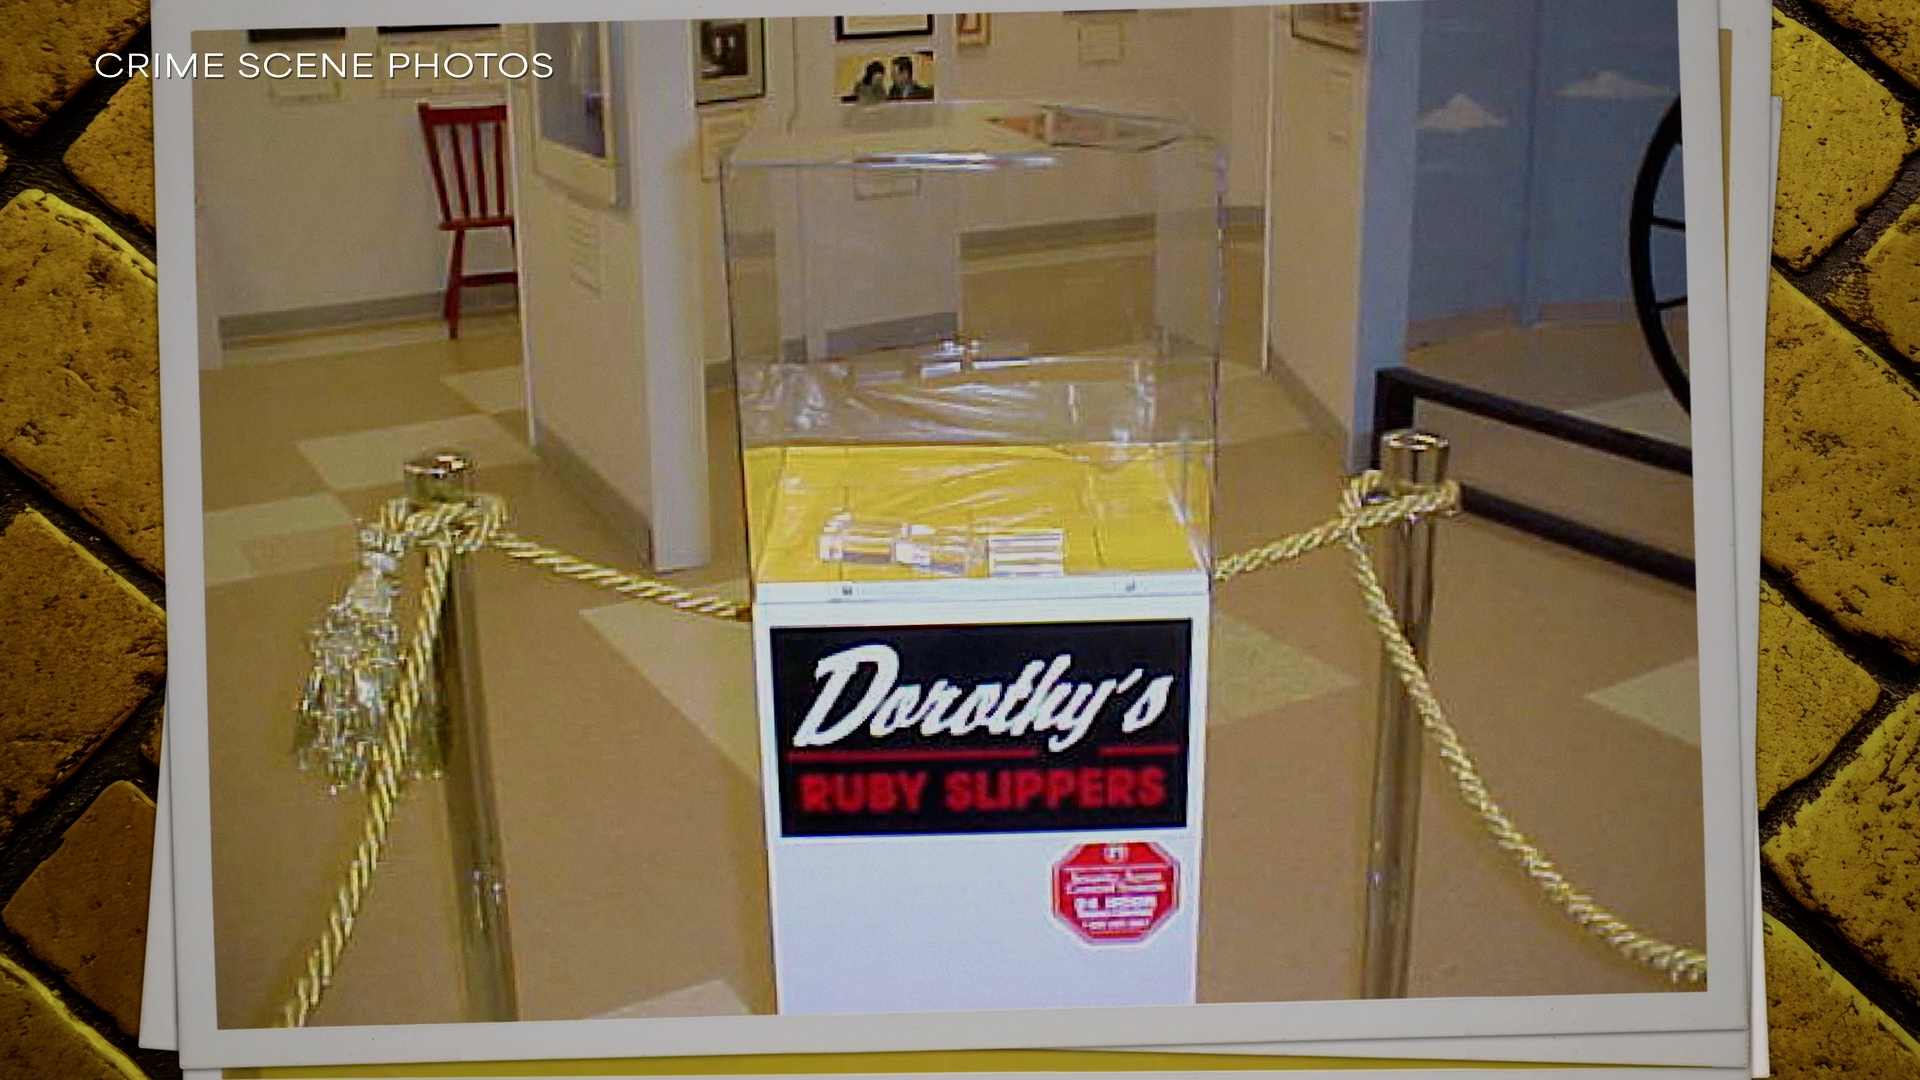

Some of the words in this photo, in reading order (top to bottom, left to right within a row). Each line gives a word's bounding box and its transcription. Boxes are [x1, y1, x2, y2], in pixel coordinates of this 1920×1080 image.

[793, 643, 1174, 752] Dorothy's
[799, 770, 927, 813] RUBY
[944, 767, 1167, 810] SLIPPERS
